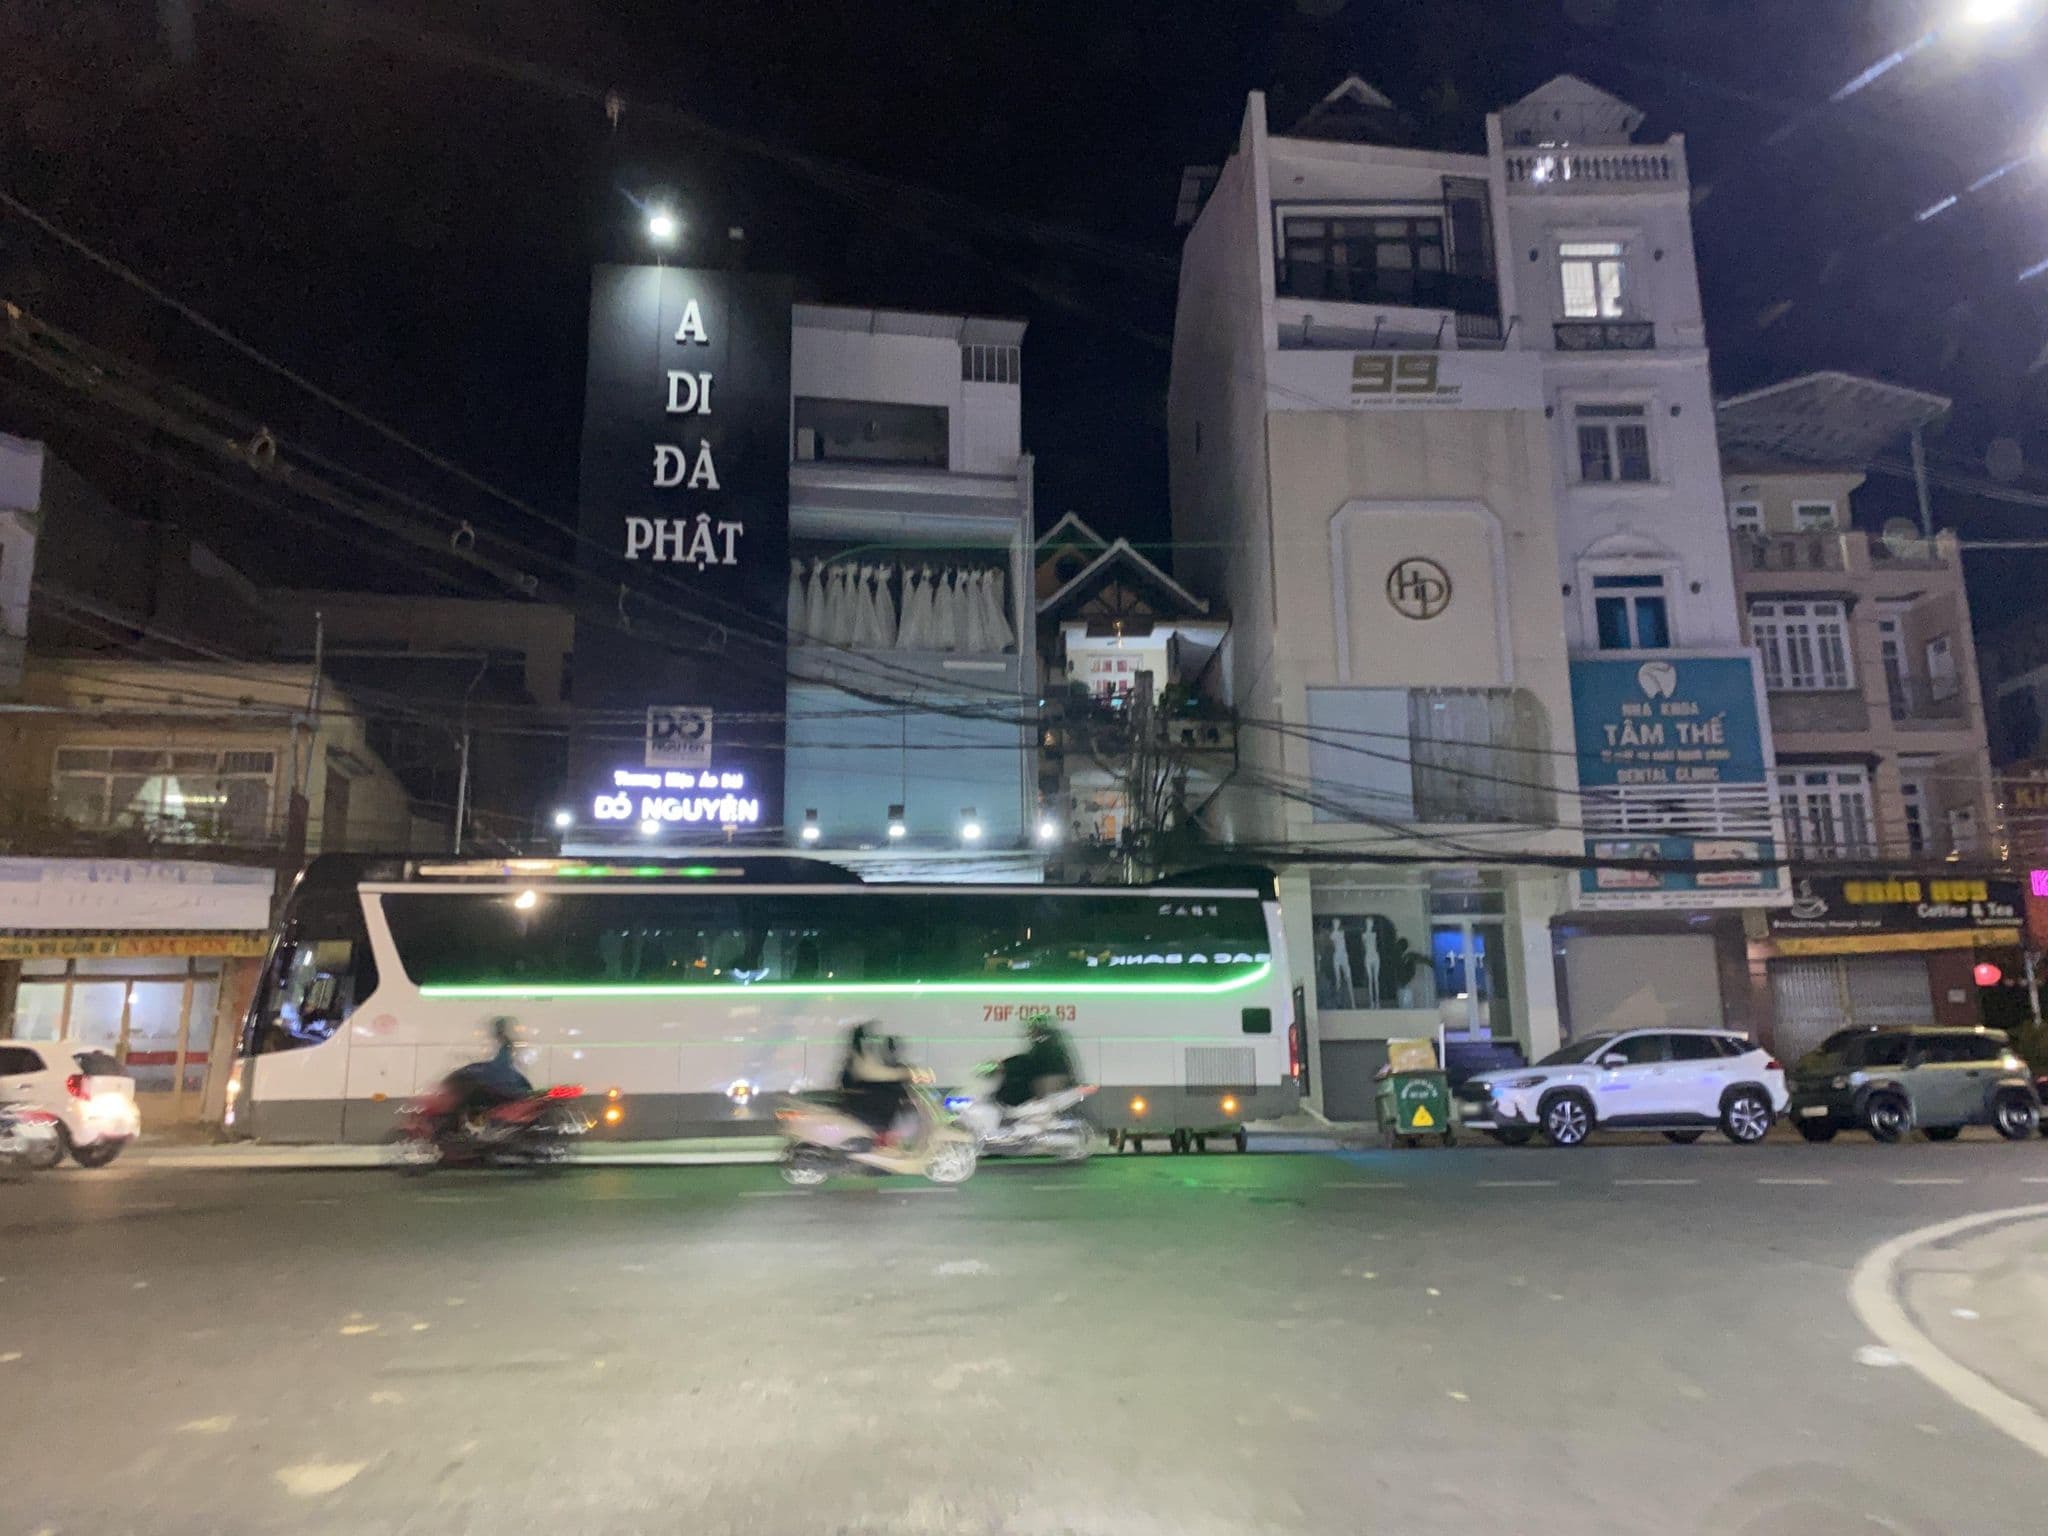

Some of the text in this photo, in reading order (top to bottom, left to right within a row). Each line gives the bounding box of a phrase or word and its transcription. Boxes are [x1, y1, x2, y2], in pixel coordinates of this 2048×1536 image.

[674, 299, 708, 342] A
[666, 369, 712, 414] DI
[1351, 355, 1438, 393] 99
[653, 440, 720, 490] ĐÀ
[625, 513, 743, 572] PHẬT
[1604, 710, 1728, 746] TÂM THẾ
